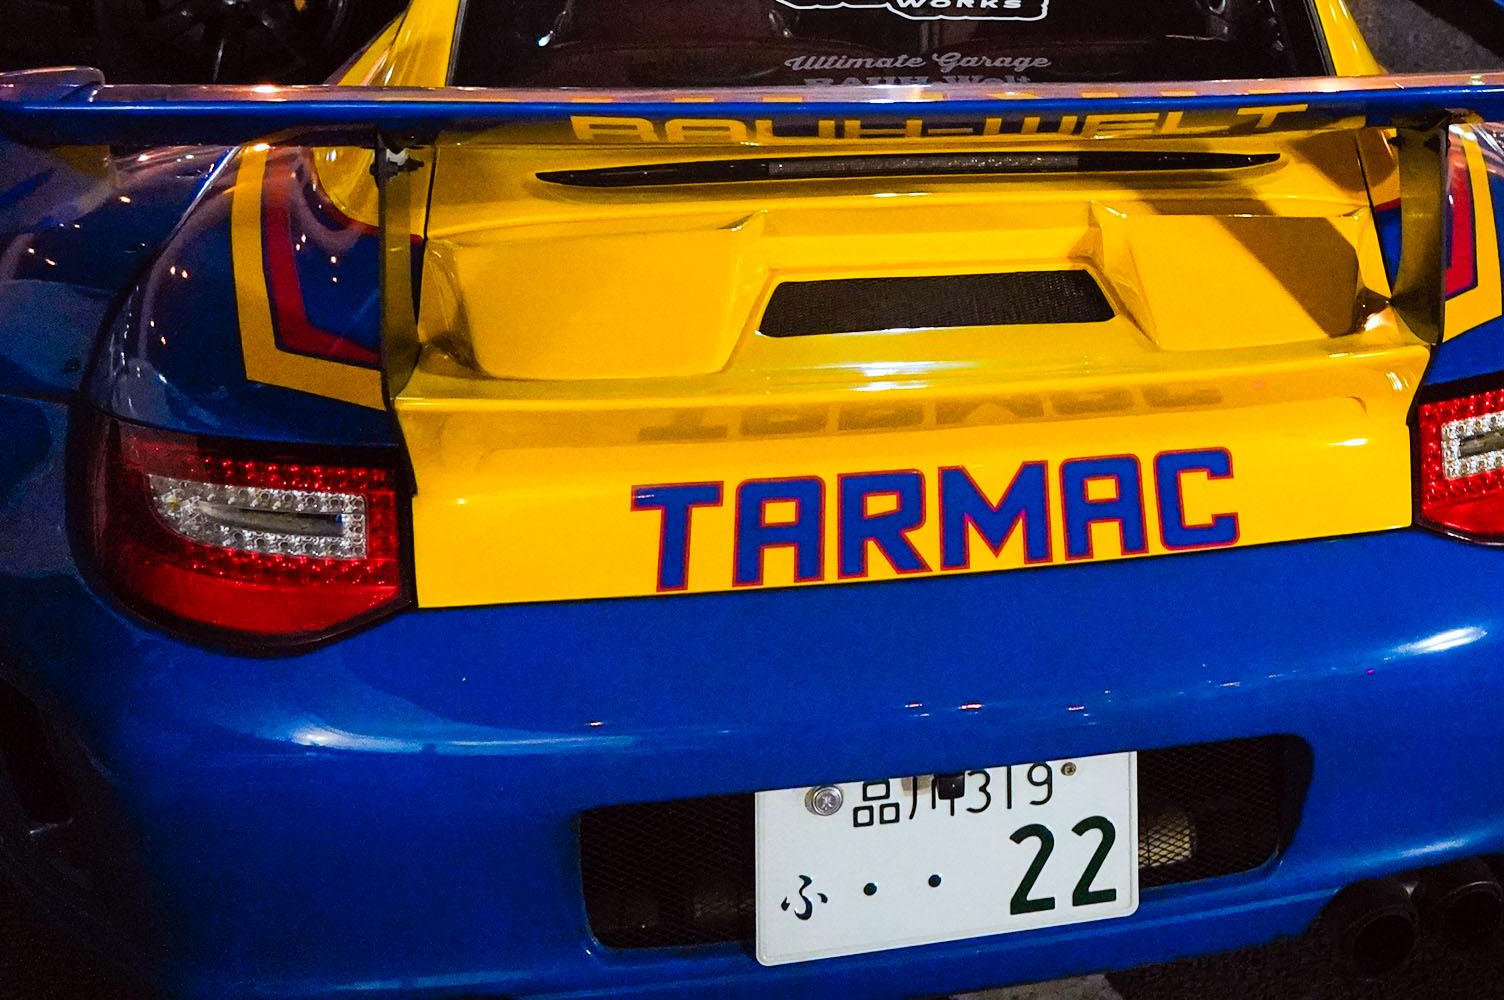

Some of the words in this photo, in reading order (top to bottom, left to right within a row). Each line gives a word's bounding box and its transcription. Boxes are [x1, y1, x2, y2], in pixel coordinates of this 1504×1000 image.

[896, 0, 1022, 9] WORKS
[784, 53, 927, 71] Ultimate
[932, 52, 1052, 73] Garage
[630, 446, 1241, 593] TARMAC
